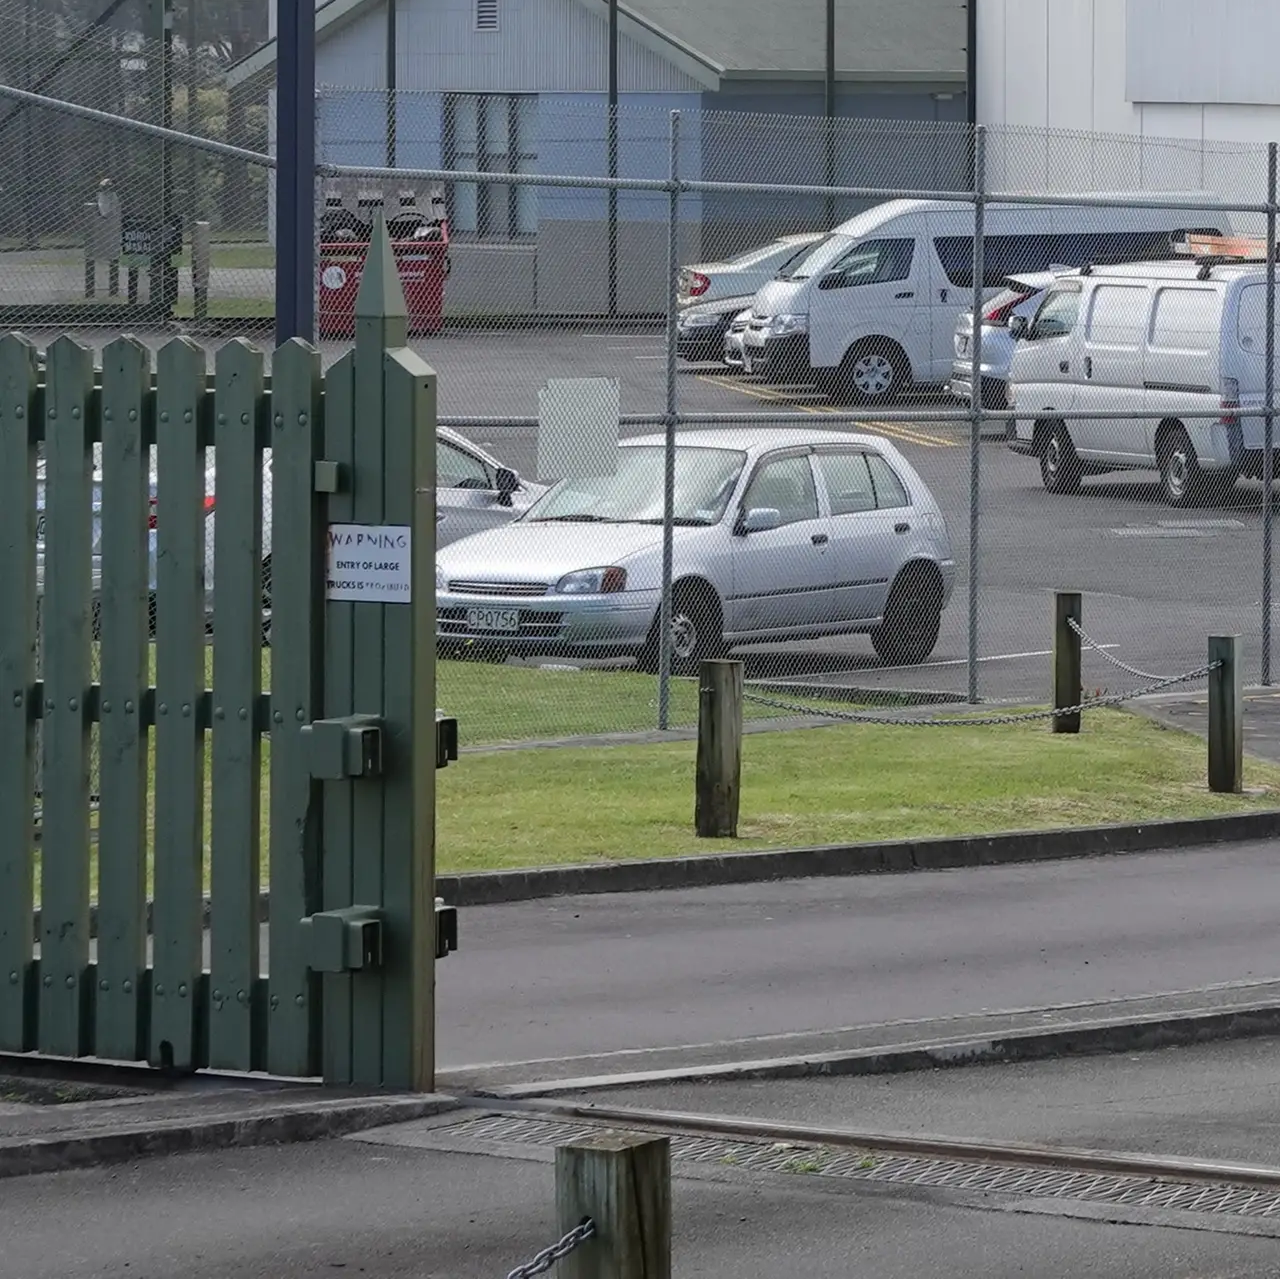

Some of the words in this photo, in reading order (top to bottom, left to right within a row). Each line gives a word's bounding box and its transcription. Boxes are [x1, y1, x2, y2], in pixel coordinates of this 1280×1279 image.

[328, 531, 407, 549] WARNING
[336, 560, 360, 570] ENTRY
[361, 561, 373, 570] OF
[374, 561, 400, 571] LARGE
[326, 580, 356, 590] TRUCKS
[357, 581, 364, 590] IS
